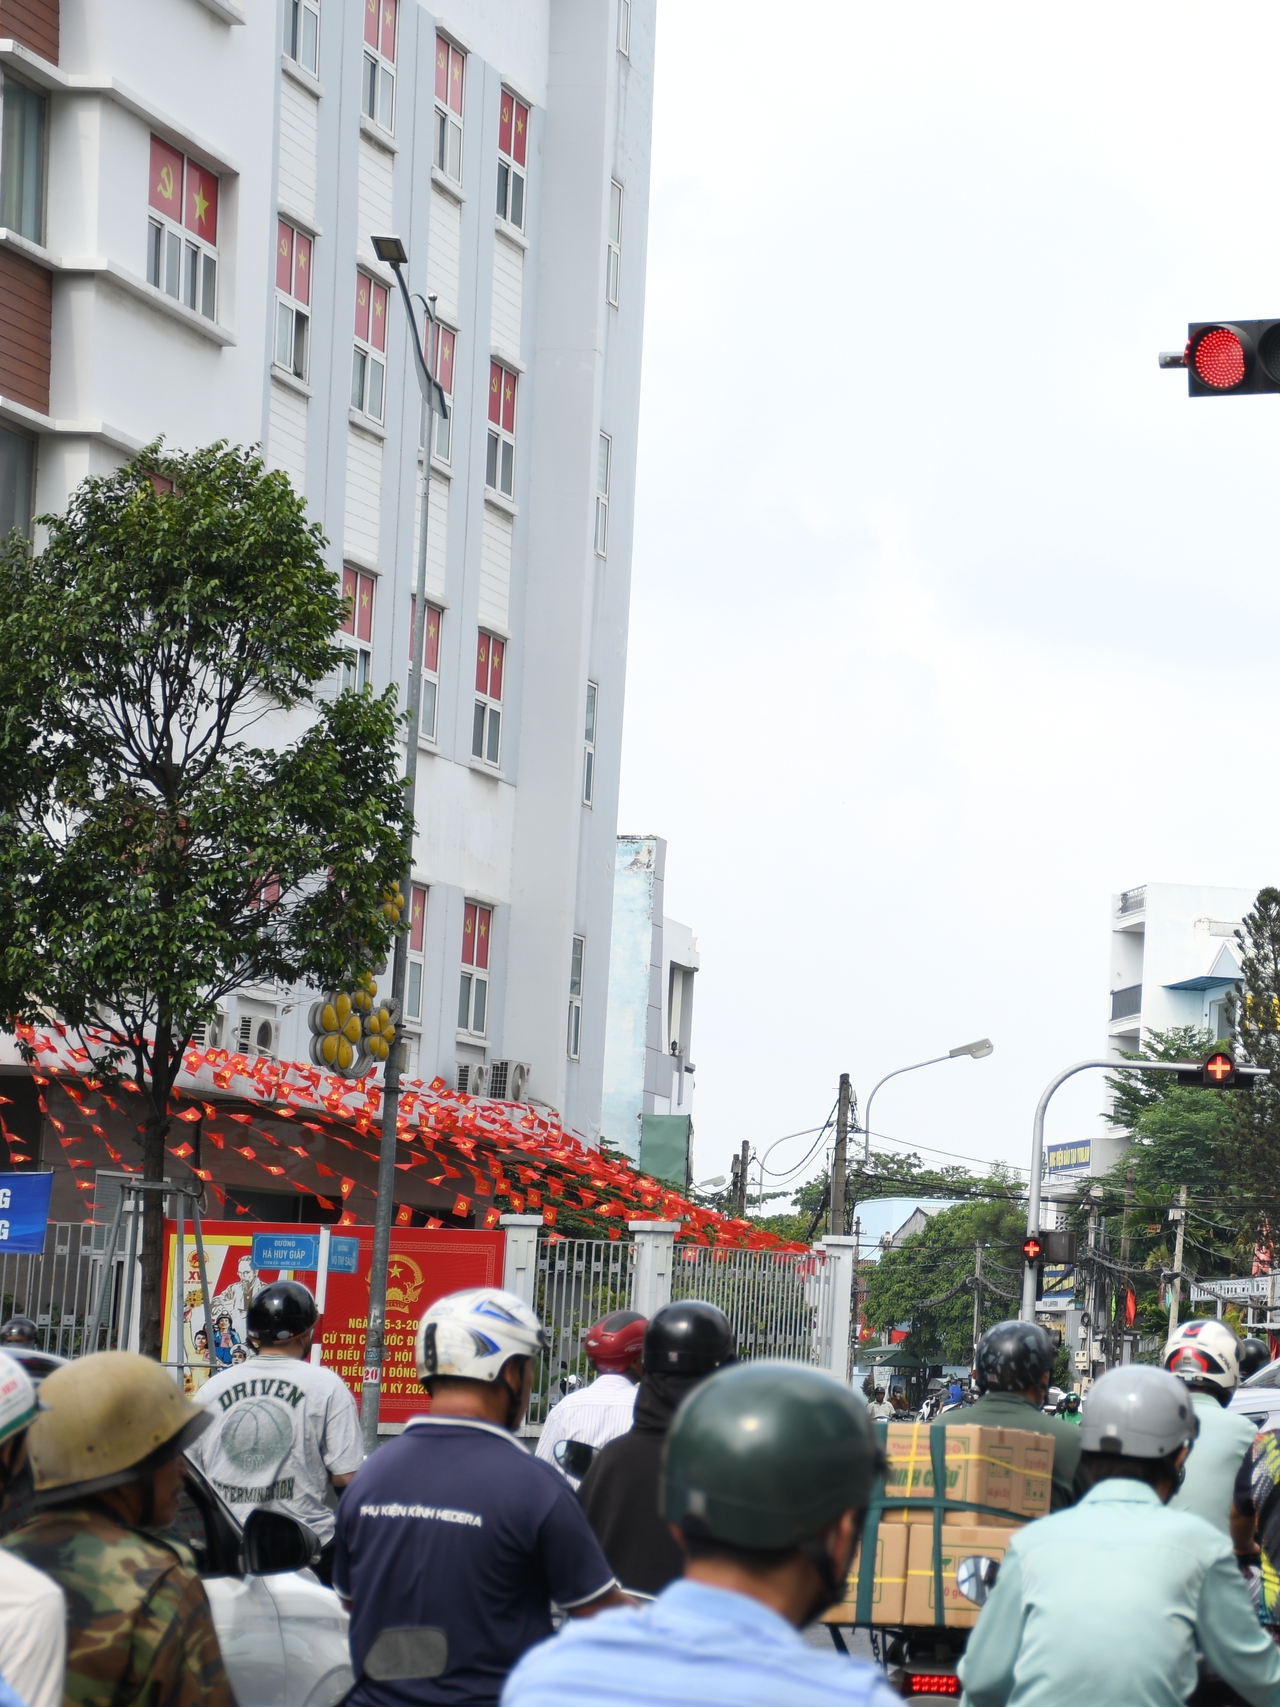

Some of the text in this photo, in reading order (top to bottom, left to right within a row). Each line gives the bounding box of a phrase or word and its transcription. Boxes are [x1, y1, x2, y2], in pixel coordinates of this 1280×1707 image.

[274, 1239, 296, 1247] ĐƯỜNG
[262, 1248, 306, 1260] HÀ HUY GIÁP
[348, 1316, 368, 1329] NGÀ
[322, 1331, 337, 1344] CỬ
[340, 1334, 356, 1345] TRI
[384, 1333, 404, 1346] ƯỚC
[337, 1347, 360, 1360] BIỂU
[395, 1349, 412, 1364] HỘI
[341, 1362, 364, 1377] BIỂU
[389, 1364, 417, 1378] ĐỒNG
[218, 1378, 305, 1412] DRIVEN
[390, 1380, 403, 1394] KỲ
[243, 1454, 265, 1471] BY
[922, 1465, 960, 1488] CU
[212, 1475, 295, 1504] TERMINATION
[380, 1502, 407, 1519] KIỆN
[407, 1503, 435, 1520] KÍNH
[435, 1508, 482, 1528] HEDERA
